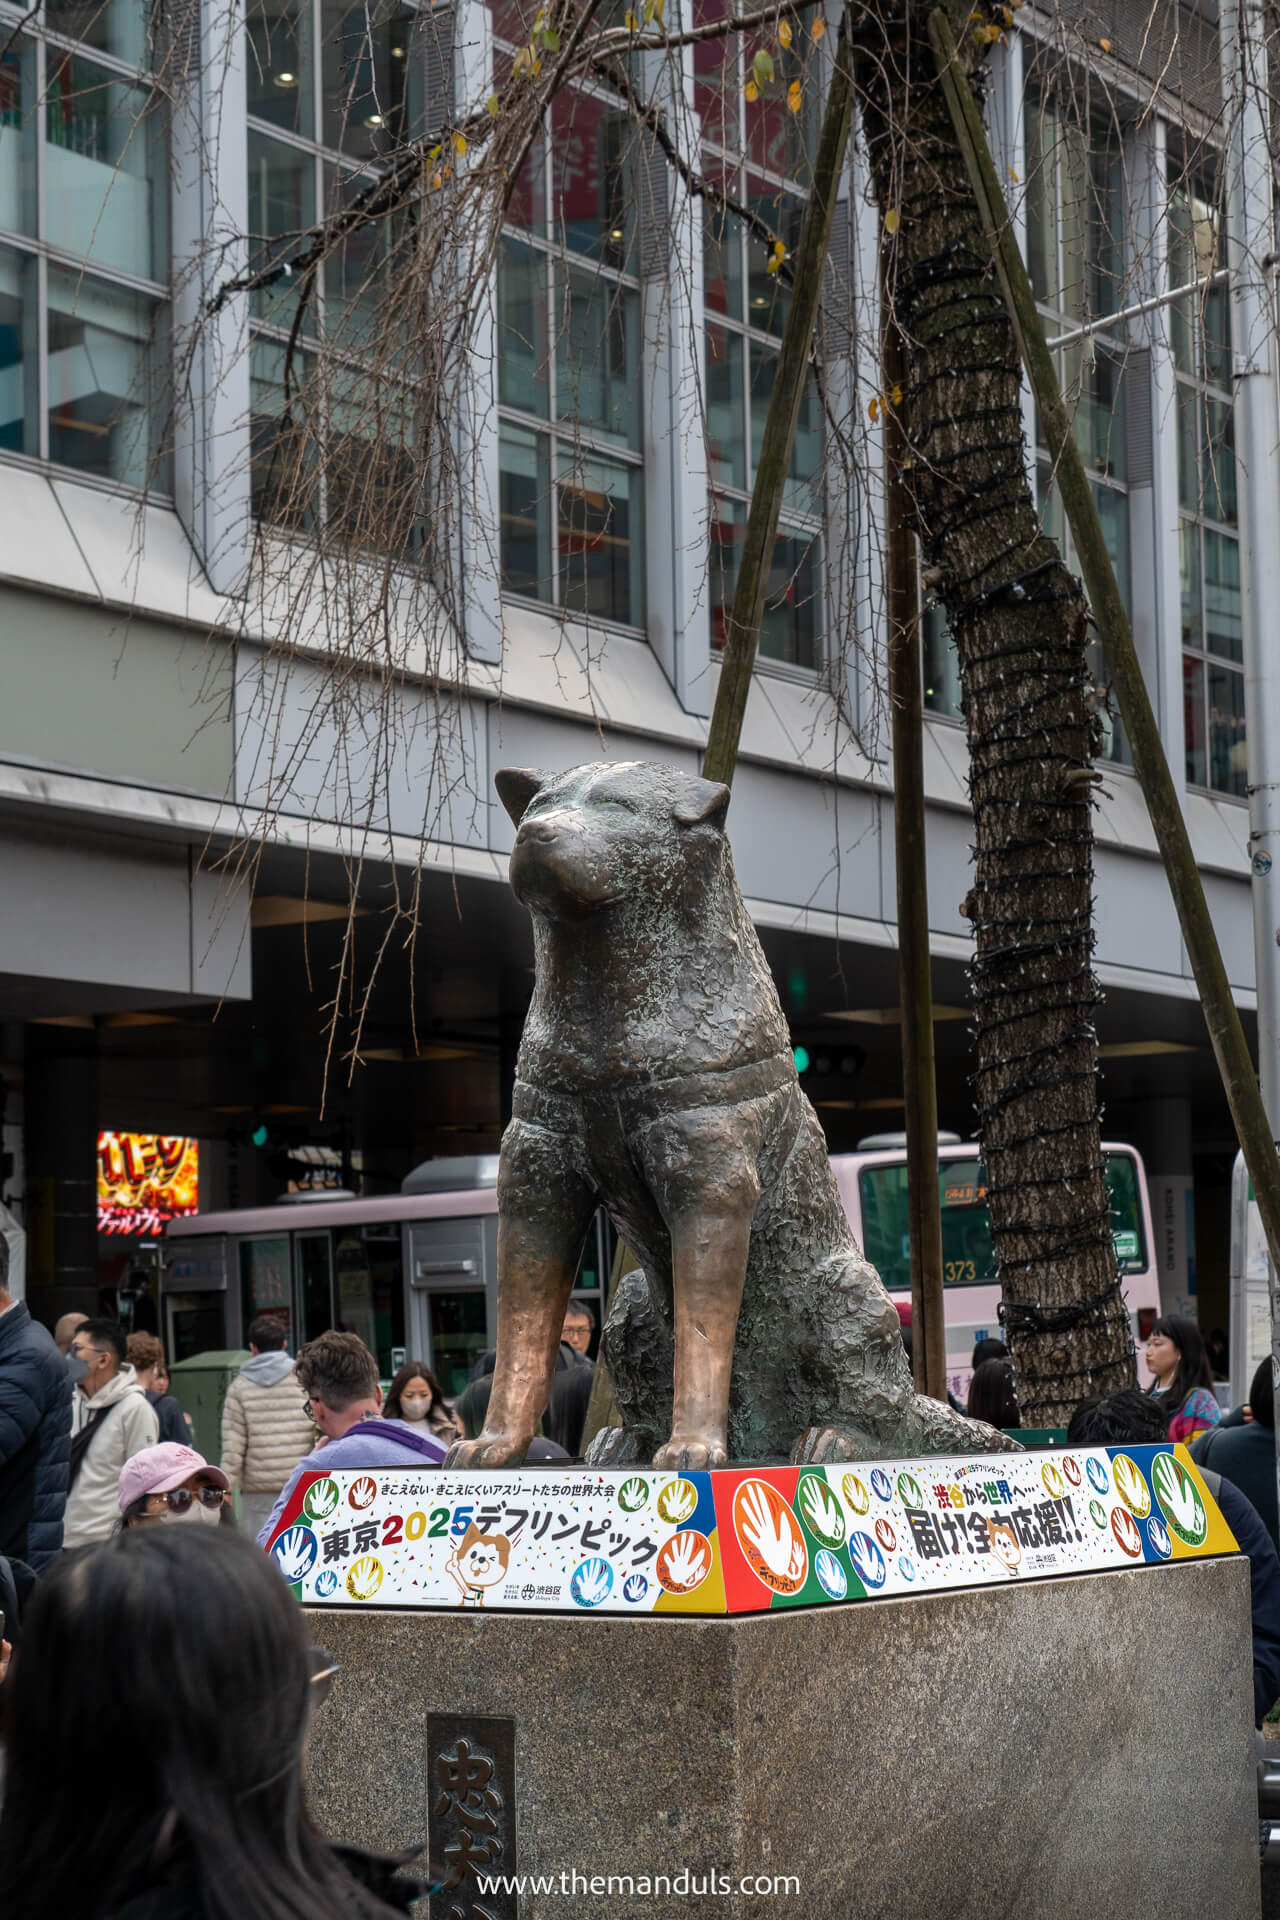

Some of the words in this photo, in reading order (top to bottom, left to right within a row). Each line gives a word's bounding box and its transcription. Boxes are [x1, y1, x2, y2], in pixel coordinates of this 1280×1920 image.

[945, 1261, 976, 1281] 373
[381, 1484, 616, 1498] きこえない・きこえにくいアスリートたちの世界大会
[321, 1501, 658, 1566] 東京2025デフリンピック
[536, 1585, 562, 1595] 渋谷区
[434, 1737, 503, 1920] 忠犬
